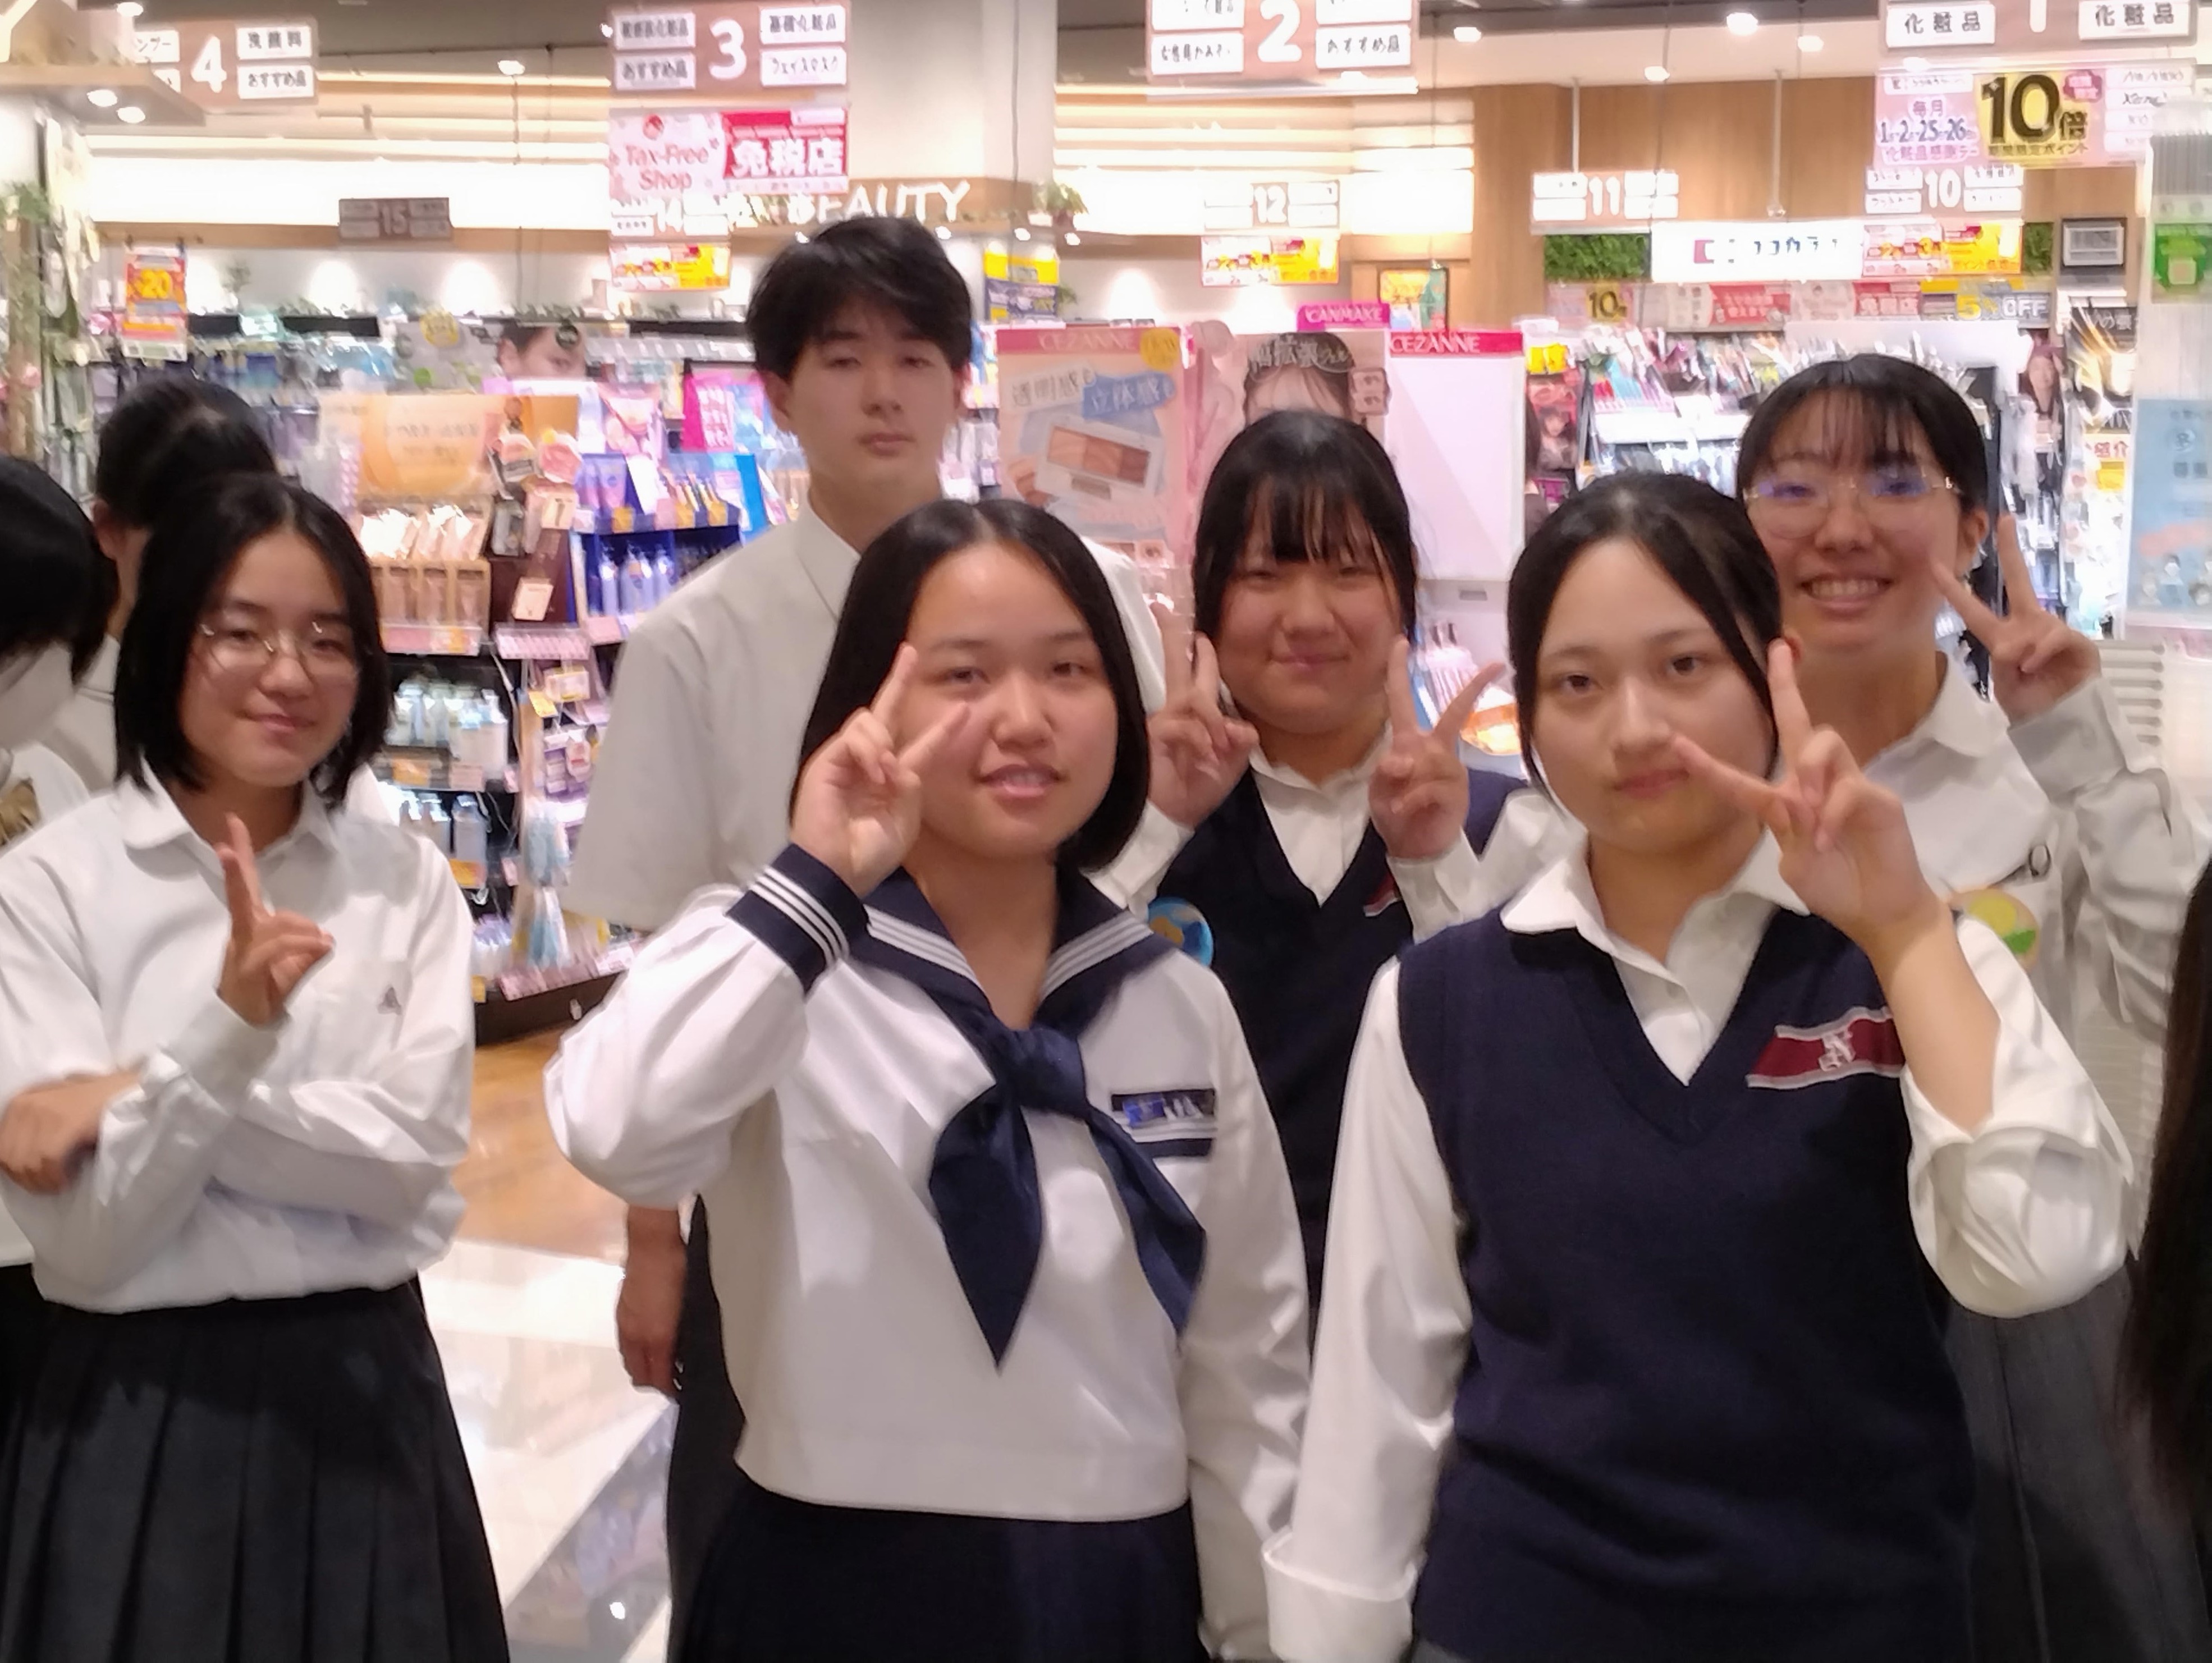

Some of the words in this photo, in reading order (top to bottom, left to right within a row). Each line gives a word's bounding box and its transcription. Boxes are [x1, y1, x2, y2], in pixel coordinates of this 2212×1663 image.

[1258, 0, 1302, 62] 2
[1904, 11, 1981, 34] 化粧品
[2095, 2, 2174, 28] 化粧品
[191, 34, 227, 94] 4
[708, 19, 748, 80] 3
[625, 143, 709, 167] Tax-Free
[731, 138, 842, 177] 免税店
[639, 169, 692, 192] Shop
[1589, 176, 1621, 216] 11
[1924, 168, 1961, 208] 10
[1254, 185, 1288, 224] 12
[1306, 305, 1382, 324] CANMAKE
[2003, 297, 2046, 317] OFF
[1389, 336, 1481, 354] CEZANNE
